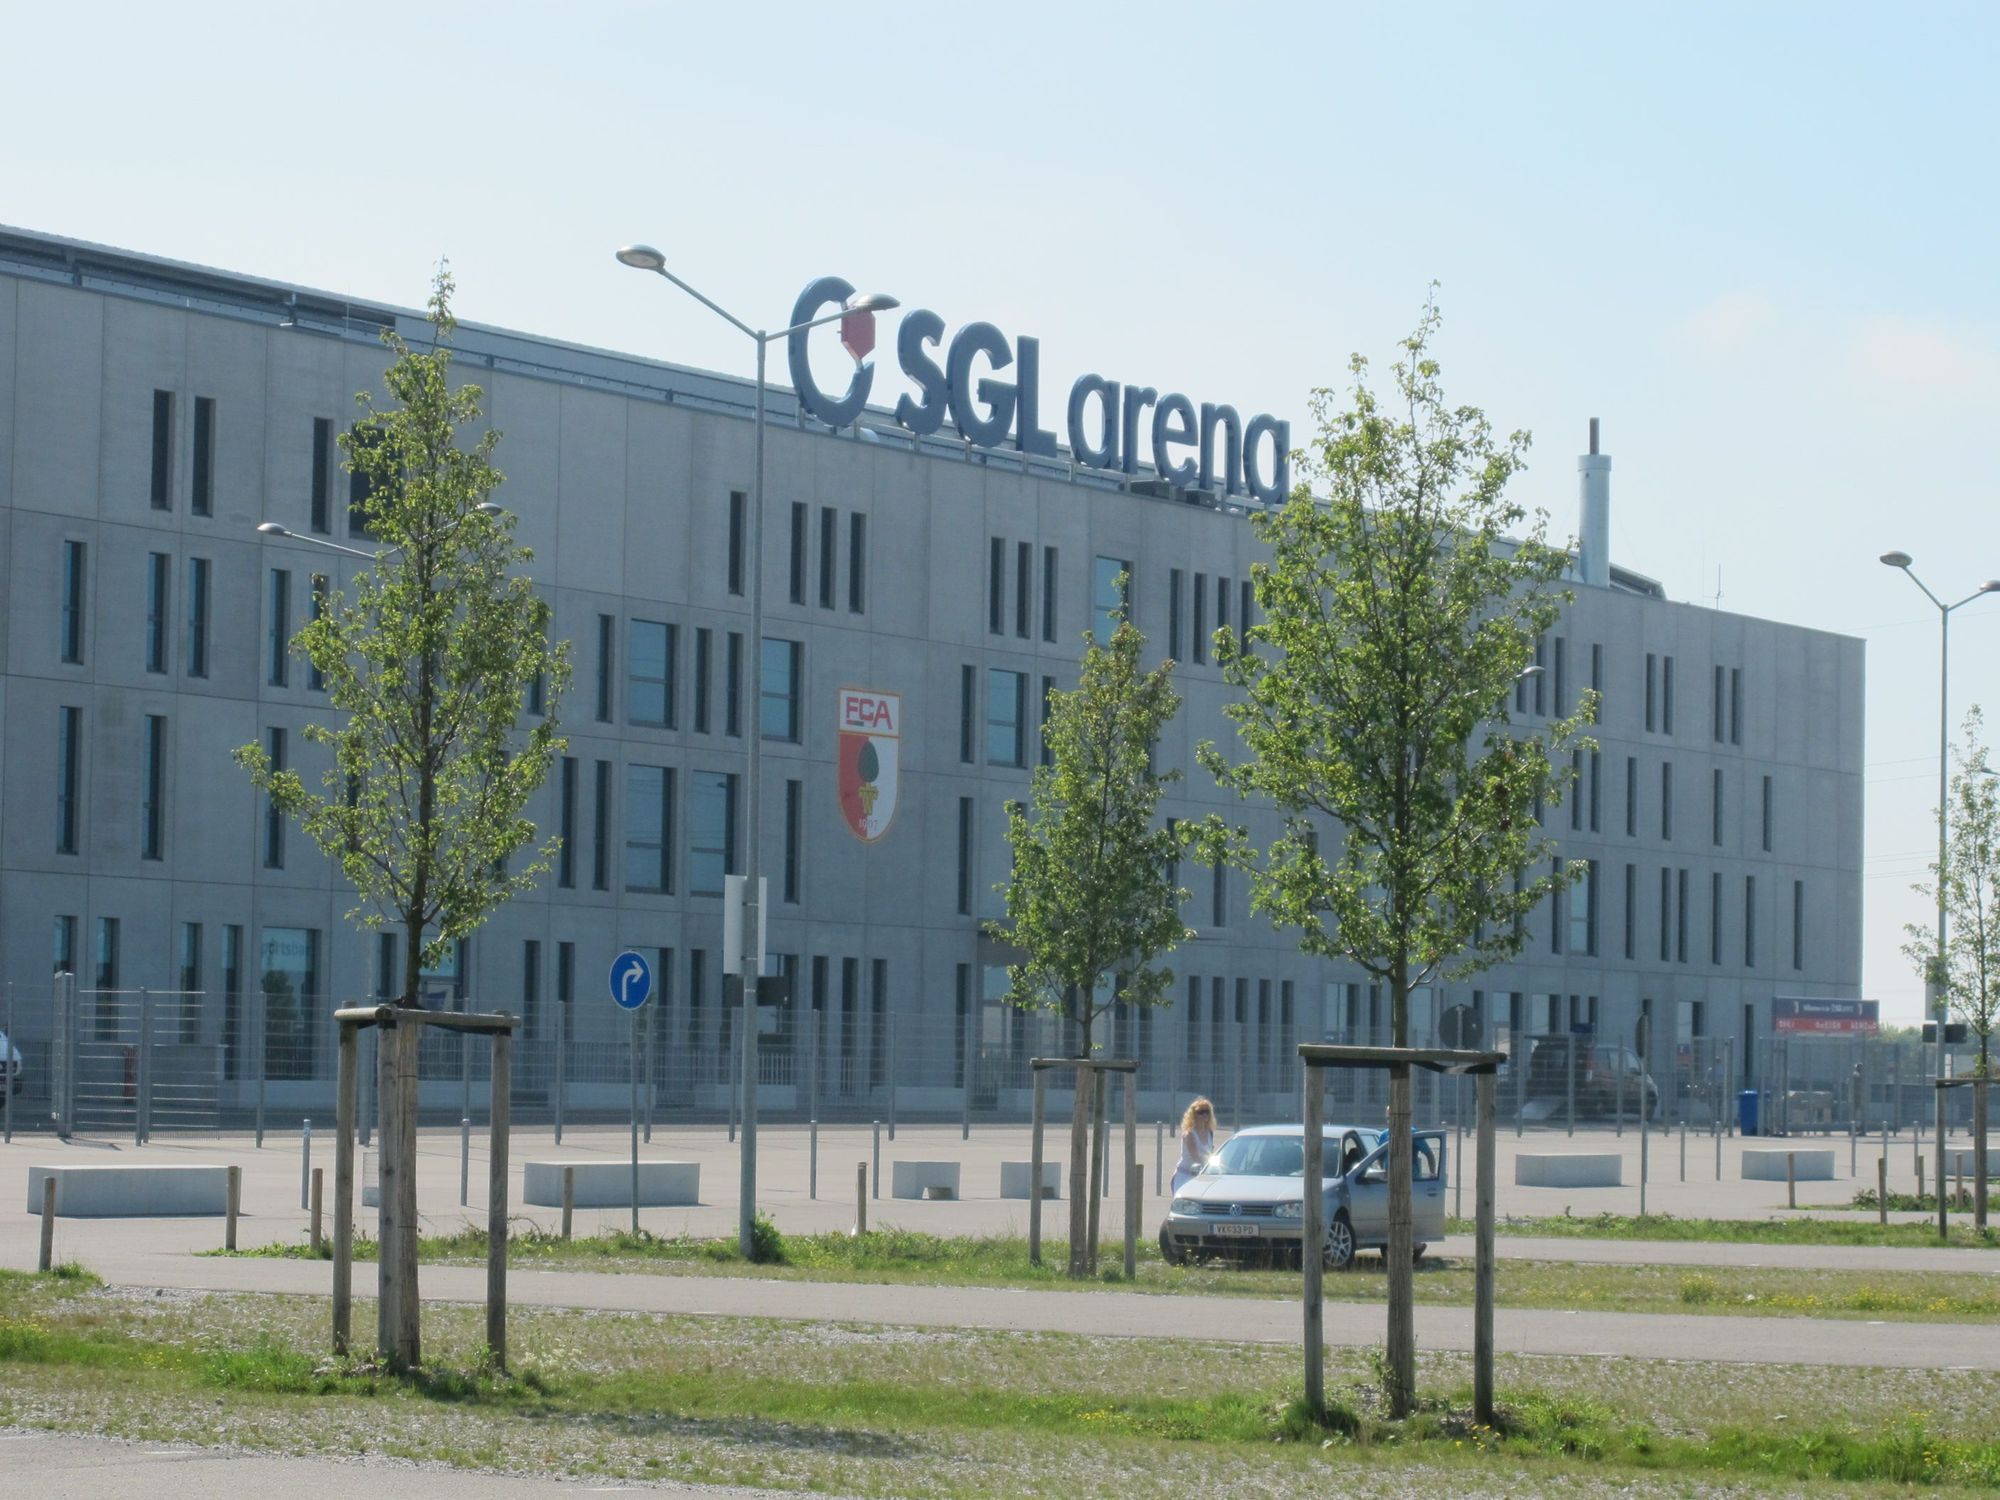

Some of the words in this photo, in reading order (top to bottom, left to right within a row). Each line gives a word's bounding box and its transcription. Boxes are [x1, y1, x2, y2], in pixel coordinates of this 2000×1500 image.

[894, 309, 1057, 458] SGL
[1067, 372, 1290, 505] arena
[846, 696, 893, 730] FCA
